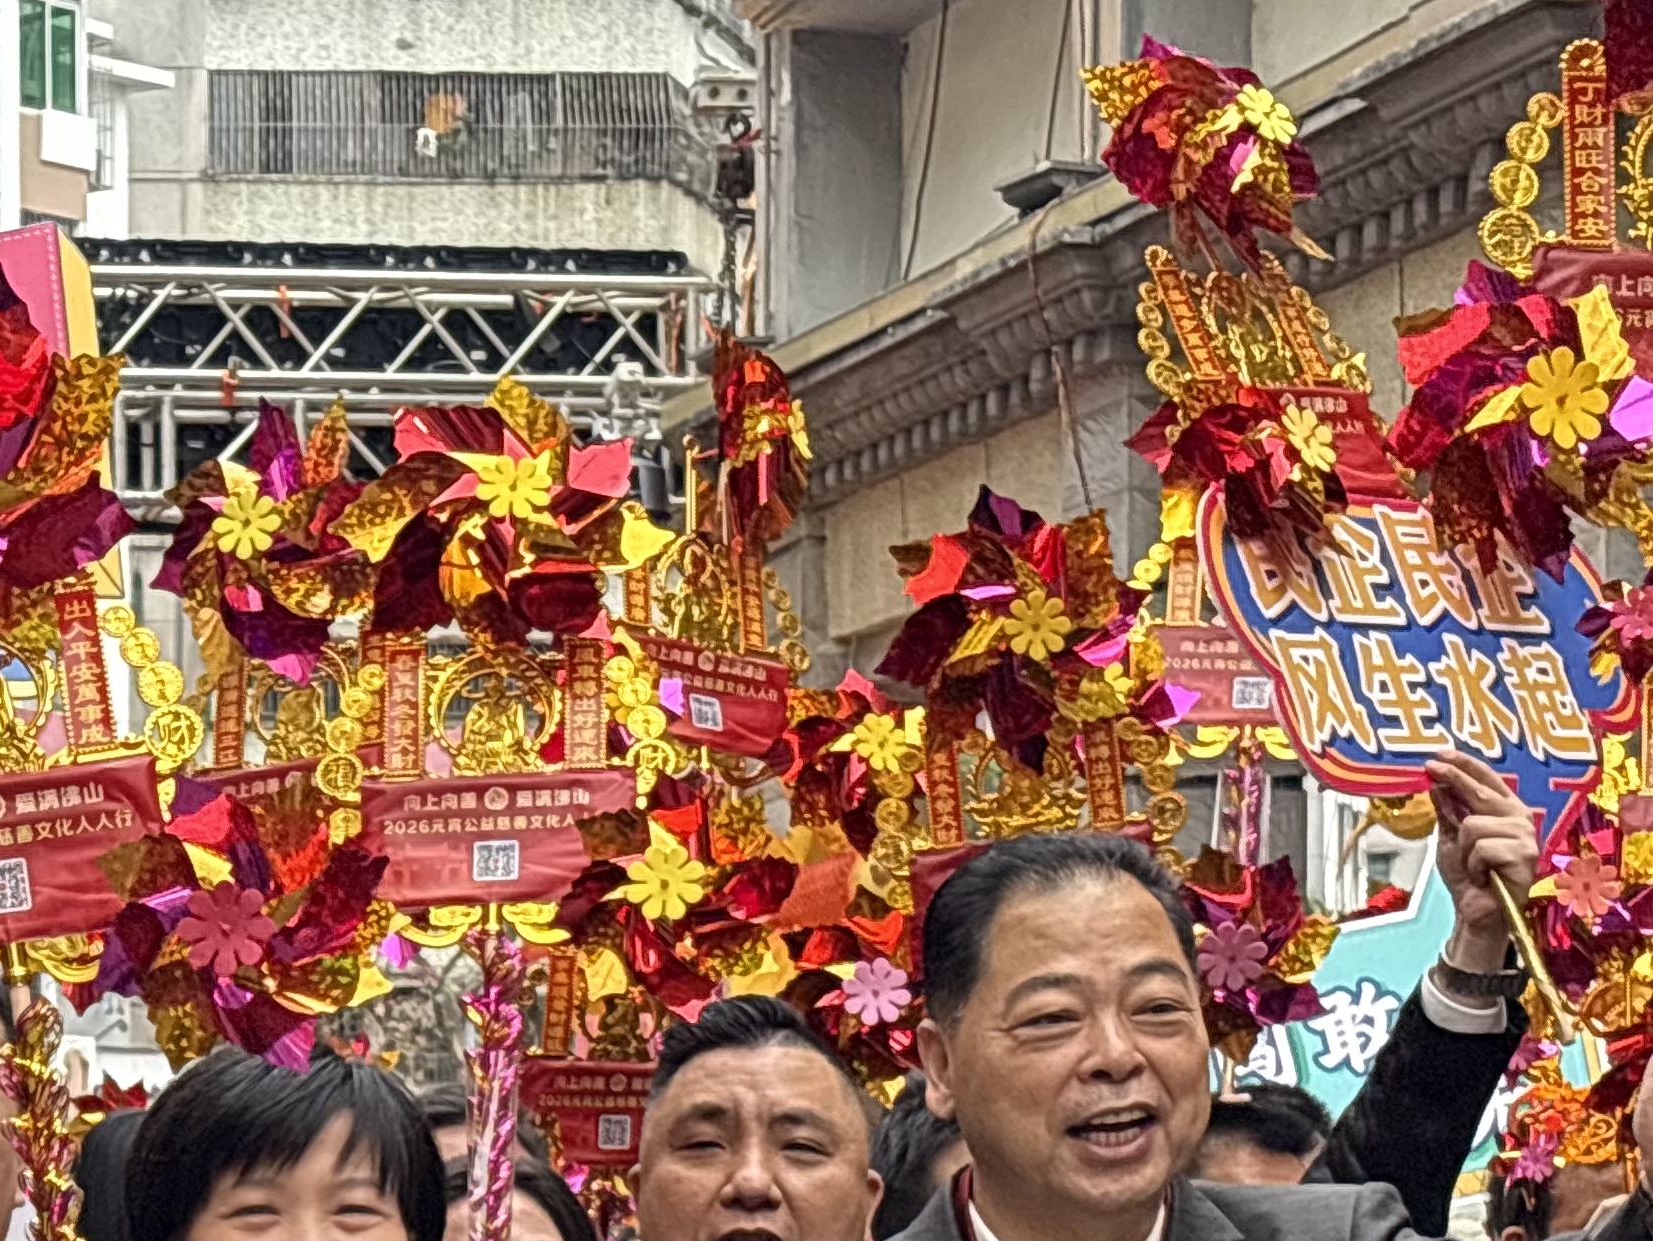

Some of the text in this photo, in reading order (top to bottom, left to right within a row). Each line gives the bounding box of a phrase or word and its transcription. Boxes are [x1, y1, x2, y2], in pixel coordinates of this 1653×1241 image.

[1269, 627, 1598, 762] 风生水起
[15, 781, 104, 816] 爱满佛山
[515, 788, 590, 809] 爱满佛山
